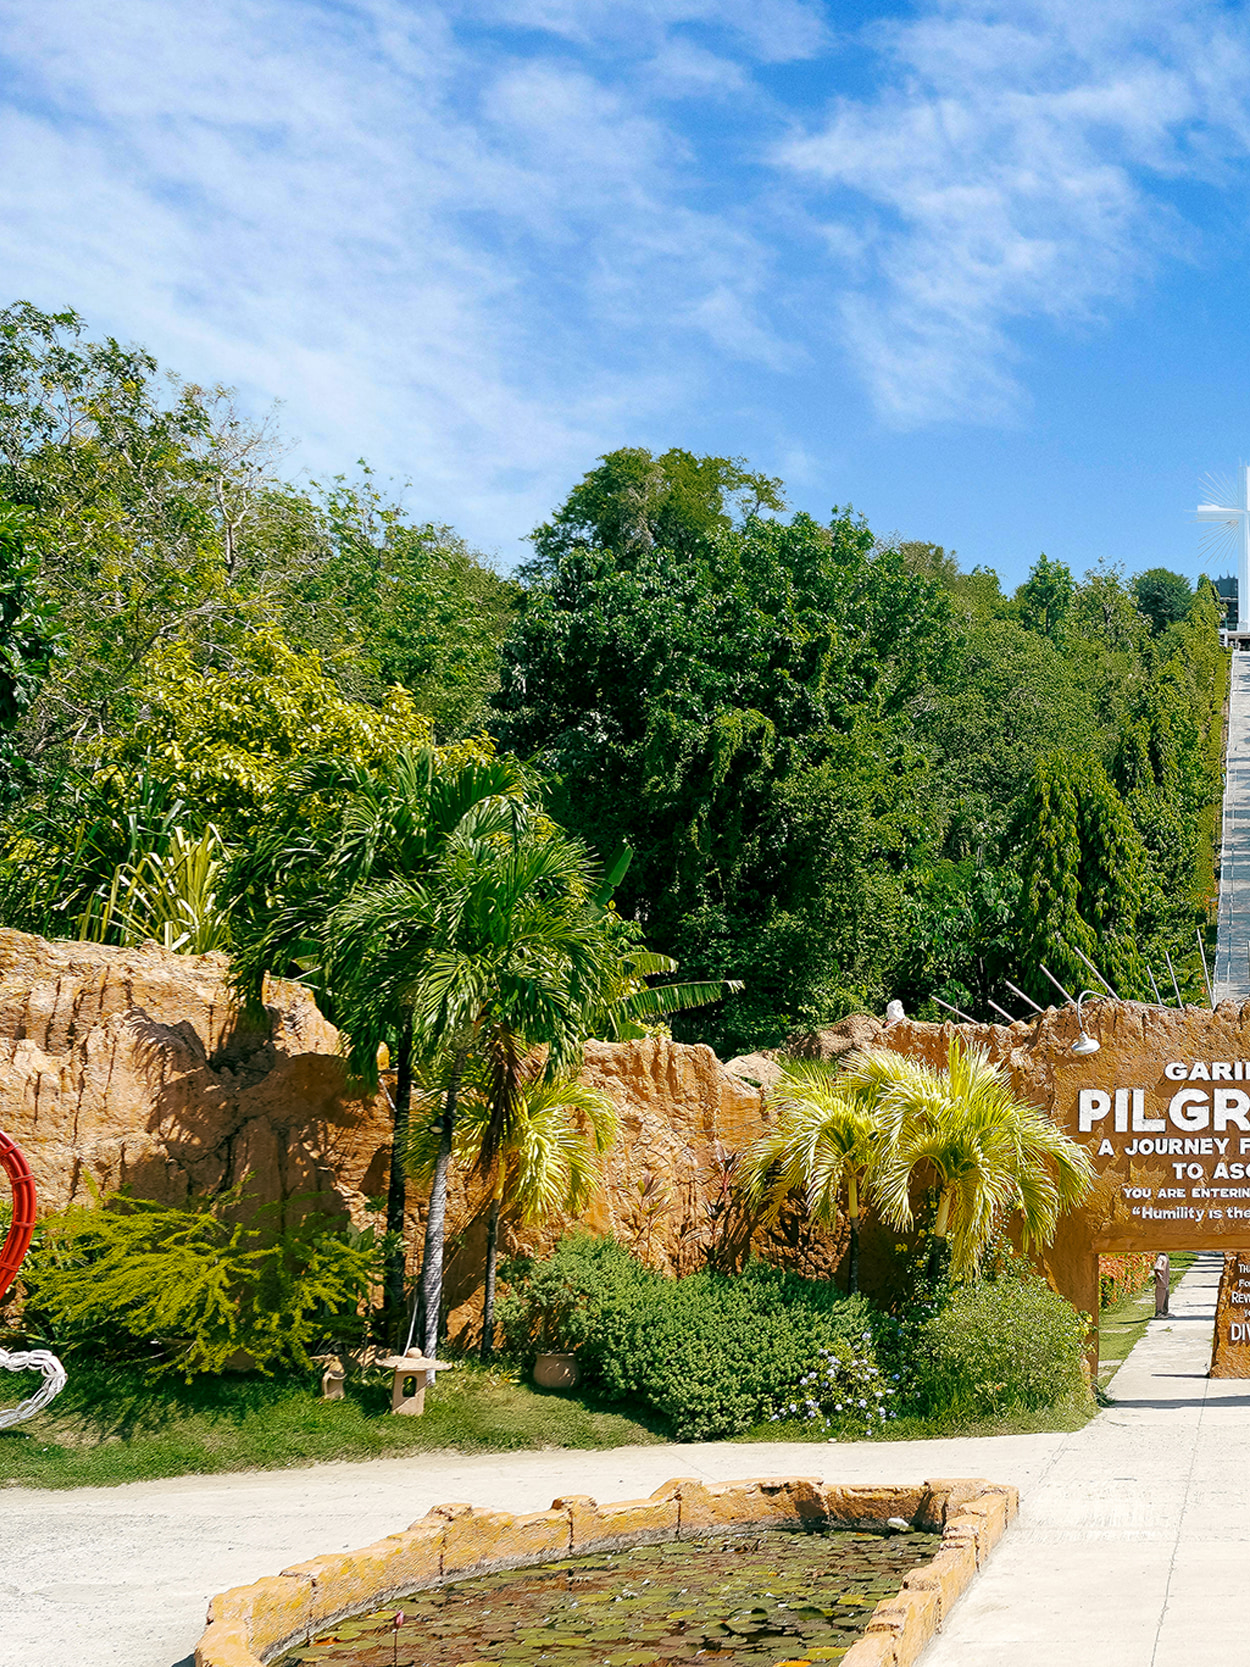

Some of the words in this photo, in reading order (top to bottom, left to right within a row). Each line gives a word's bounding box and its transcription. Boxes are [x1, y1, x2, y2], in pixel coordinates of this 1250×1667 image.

[1098, 1138, 1115, 1155] A
[1125, 1138, 1230, 1155] JOURNEY
[1172, 1162, 1204, 1180] TO
[1123, 1187, 1152, 1199] YOU
[1157, 1187, 1186, 1198] ARE
[1208, 1206, 1223, 1219] is
